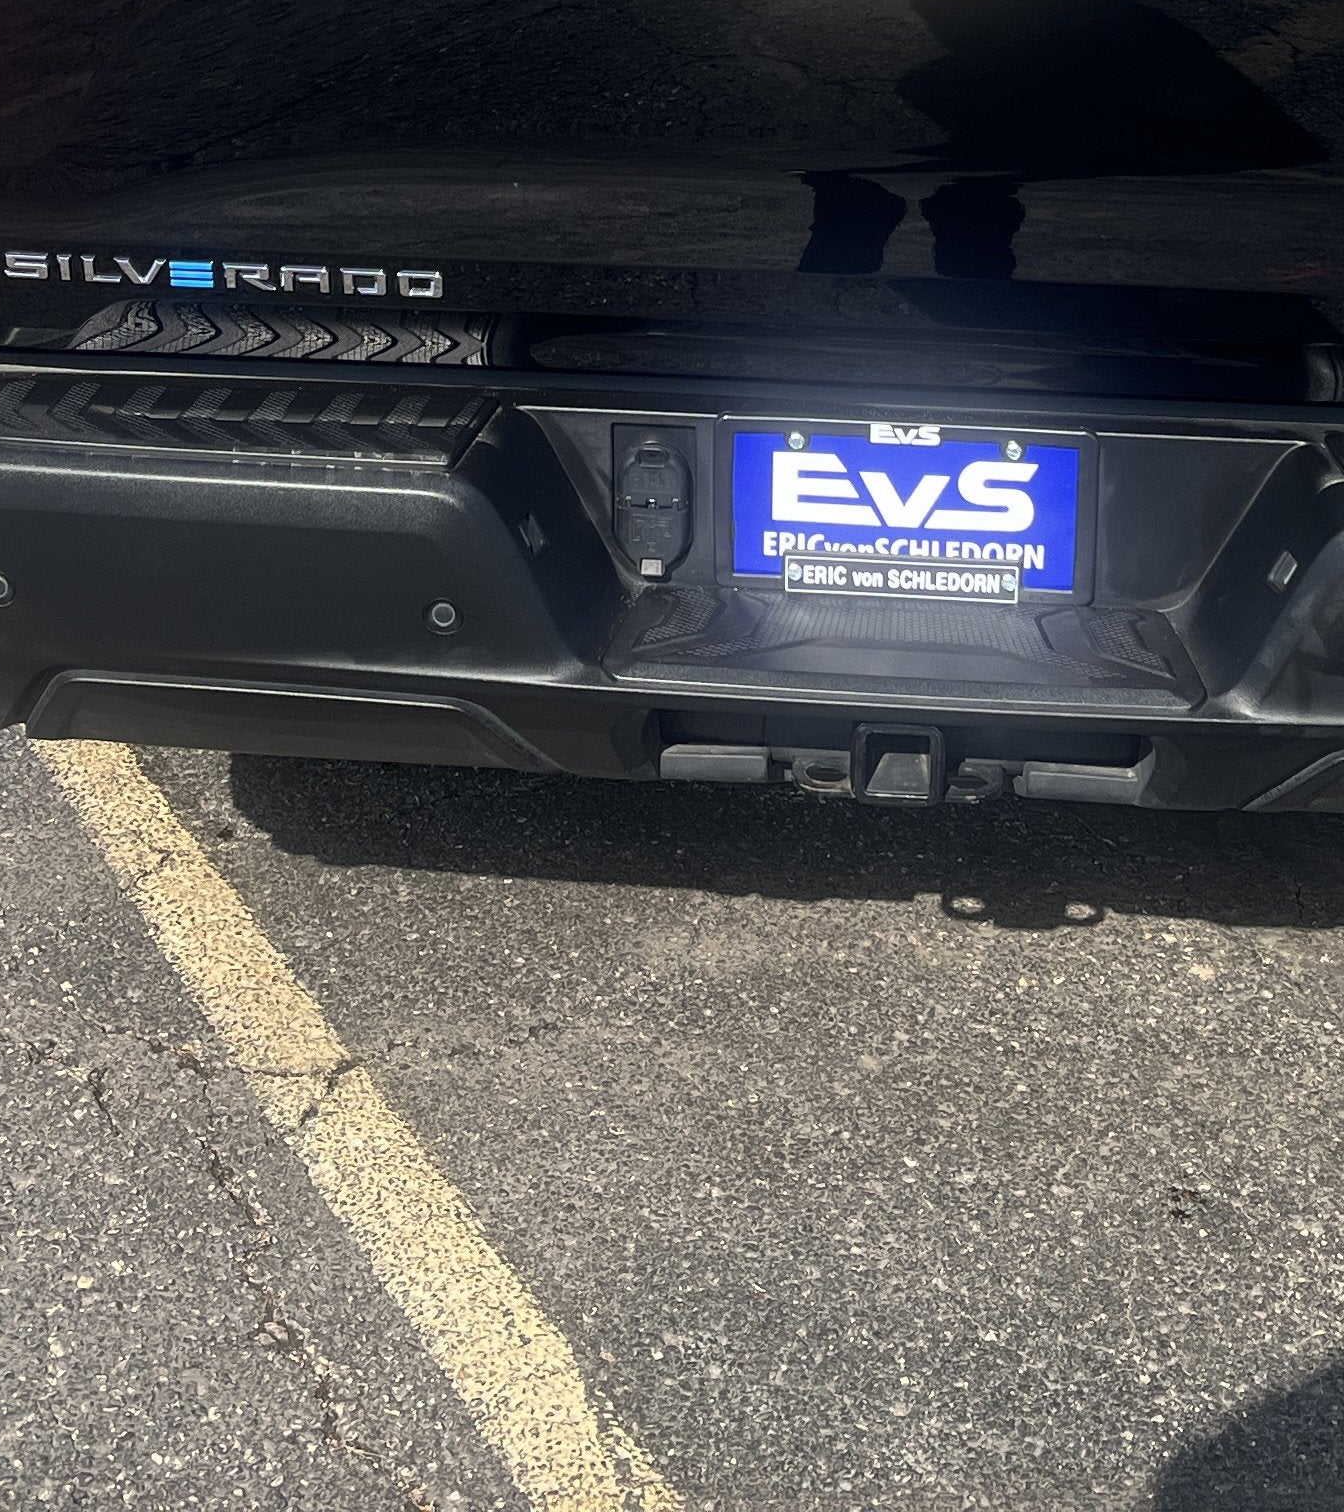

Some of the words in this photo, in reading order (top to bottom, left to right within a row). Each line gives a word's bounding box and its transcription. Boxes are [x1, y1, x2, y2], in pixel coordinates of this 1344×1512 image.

[3, 250, 444, 298] SILVERADO
[802, 564, 847, 586] ERIC
[851, 570, 884, 588] von
[887, 569, 1000, 594] SCHLEDORN
